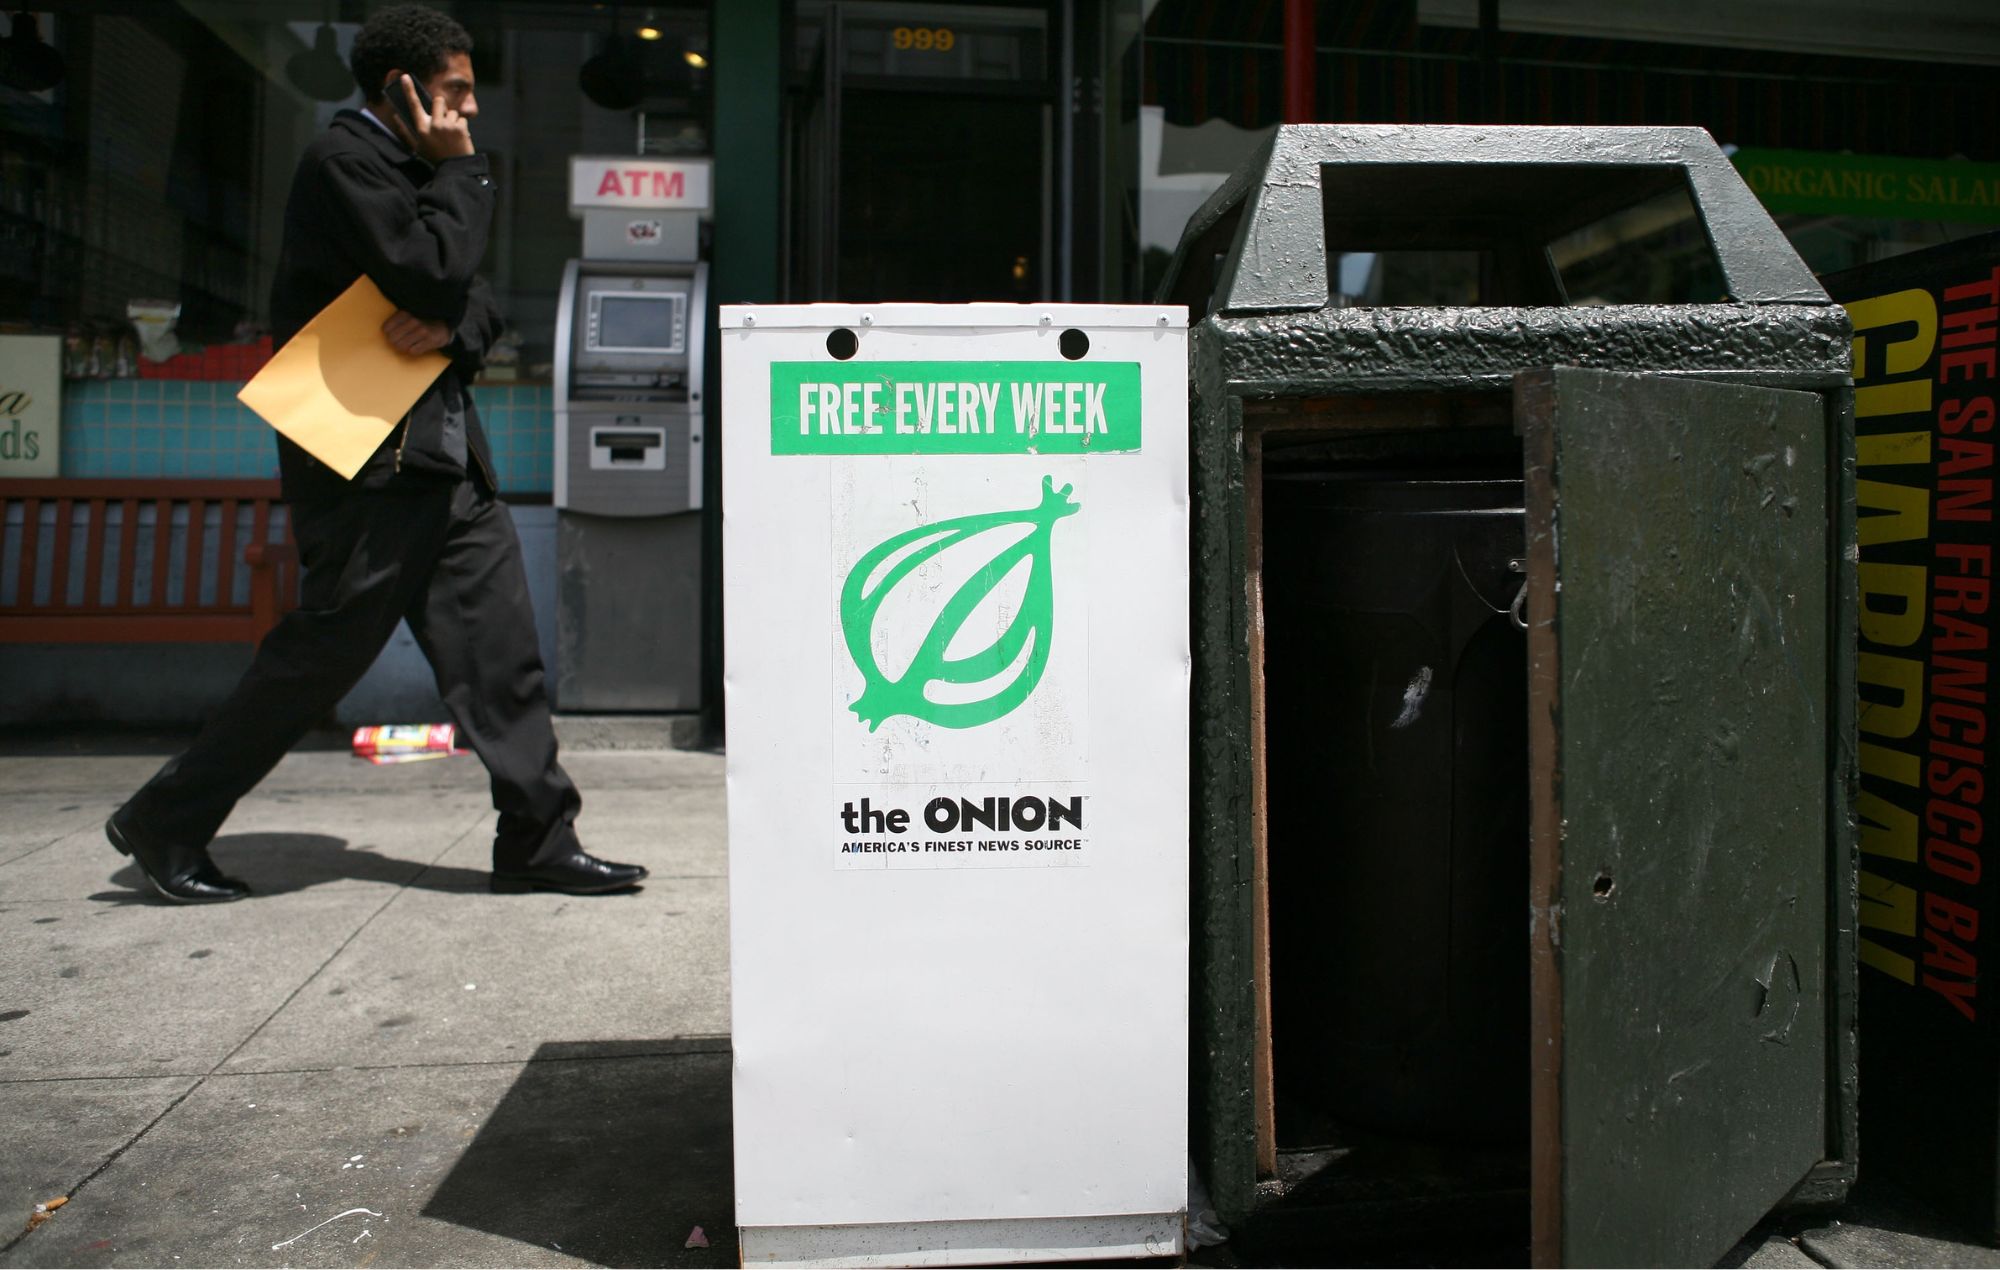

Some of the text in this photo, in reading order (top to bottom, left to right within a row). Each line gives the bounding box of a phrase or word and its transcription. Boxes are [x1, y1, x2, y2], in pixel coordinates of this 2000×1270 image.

[893, 27, 954, 51] 999
[597, 169, 685, 198] ATM
[1750, 163, 1898, 201] ORGANIC
[799, 382, 1109, 435] FREE EVERY WEEK
[1921, 267, 2000, 1023] THE SAN FRANCISCO BAY
[841, 795, 1083, 833] the ONION
[841, 841, 920, 853] AMERICA'S
[925, 840, 974, 852] FINEST
[978, 840, 1020, 851] NEWS
